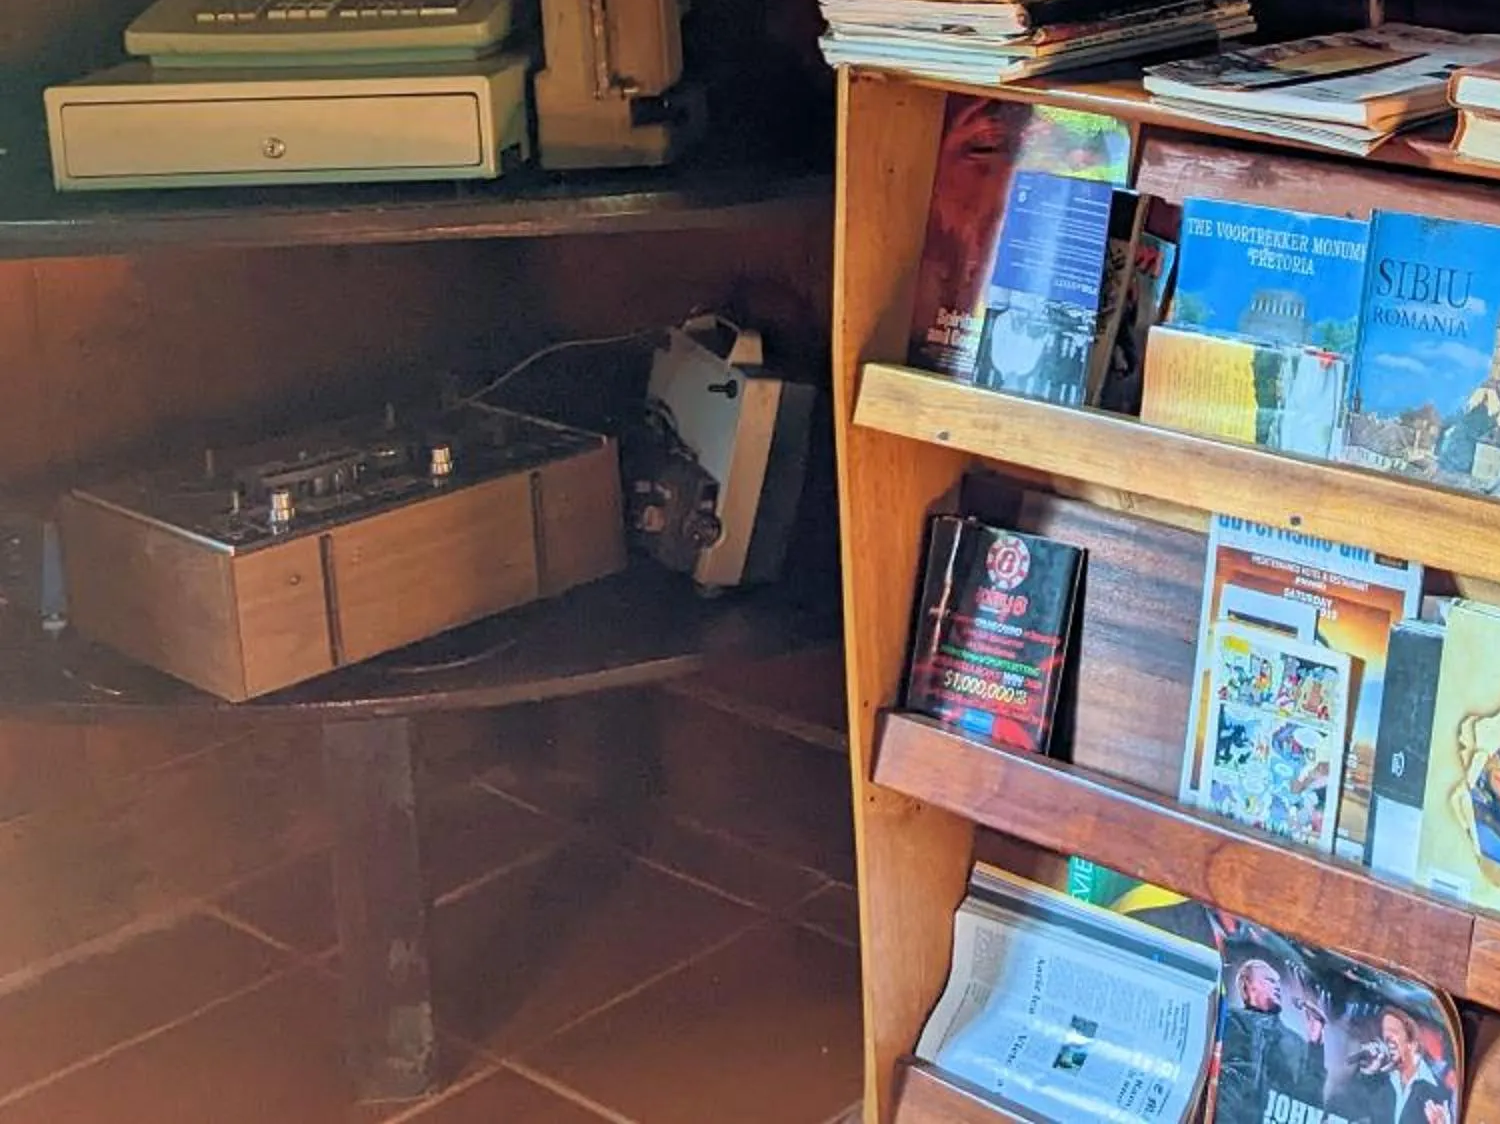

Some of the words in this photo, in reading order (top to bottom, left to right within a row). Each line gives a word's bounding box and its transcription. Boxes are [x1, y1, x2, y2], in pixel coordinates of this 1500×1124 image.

[1187, 217, 1214, 237] THE
[1216, 221, 1310, 253] VOORTREKKER
[1247, 247, 1315, 276] PRETORIA
[1375, 256, 1475, 311] SIBIU
[1372, 304, 1470, 340] ROMANIA
[943, 669, 1016, 704] $1,000,000
[1263, 1088, 1325, 1124] JOHN
